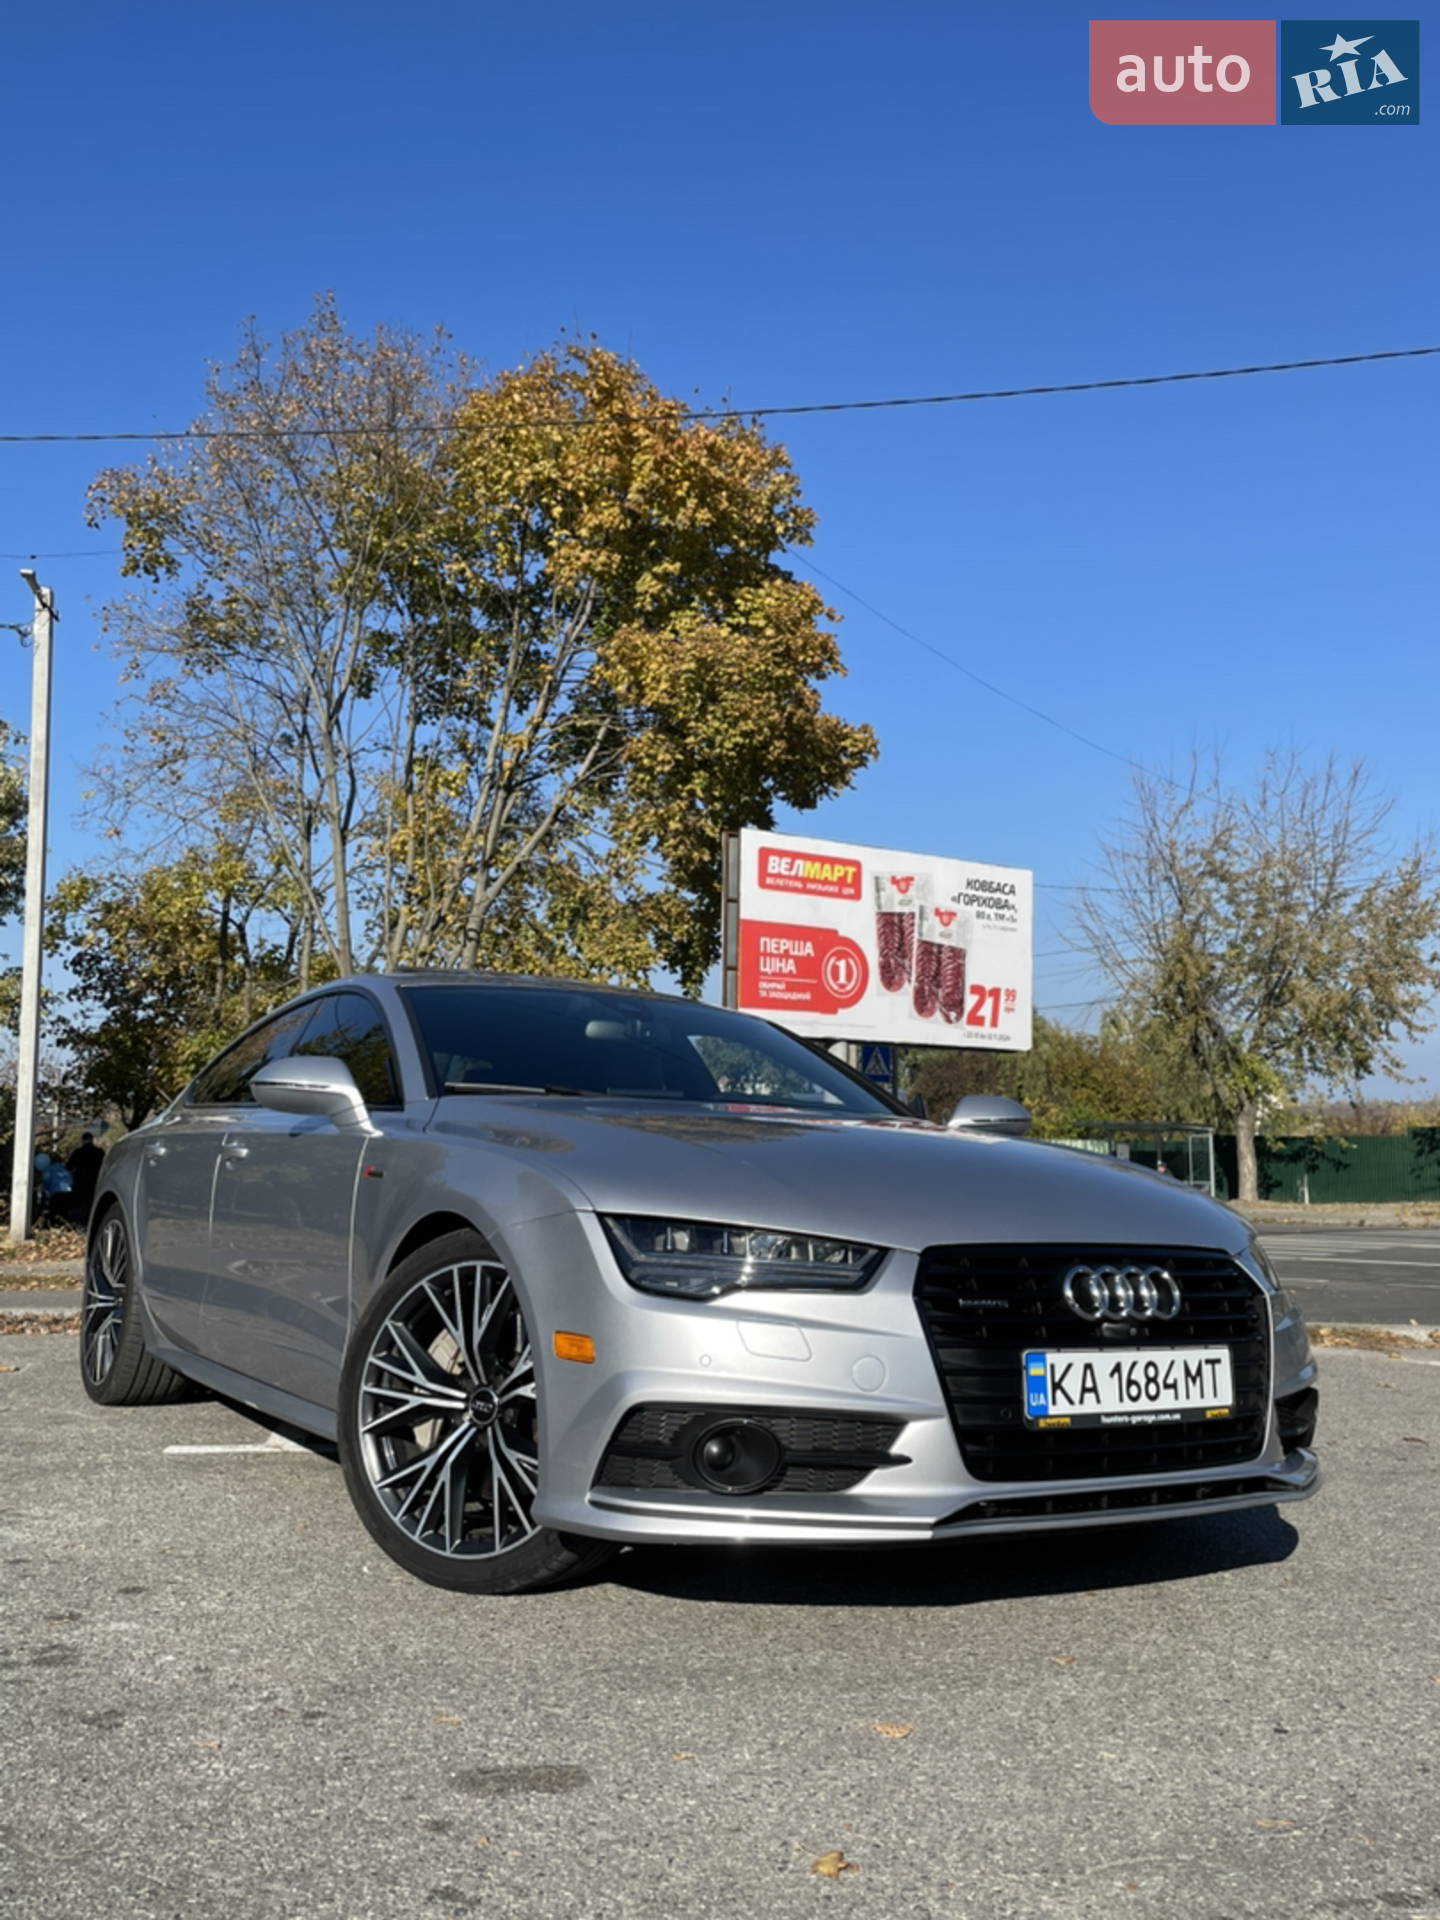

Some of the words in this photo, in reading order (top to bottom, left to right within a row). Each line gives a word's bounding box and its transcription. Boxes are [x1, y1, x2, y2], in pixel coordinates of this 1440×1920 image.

[766, 855, 857, 885] ВЕЛМАРТ
[966, 878, 1017, 896] КОВБАСА
[760, 936, 815, 957] ПЕРША
[760, 956, 797, 975] ЦІНА
[834, 958, 849, 985] 1
[966, 984, 1001, 1028] 21
[1050, 1363, 1101, 1406] KA
[1030, 1393, 1046, 1407] UA
